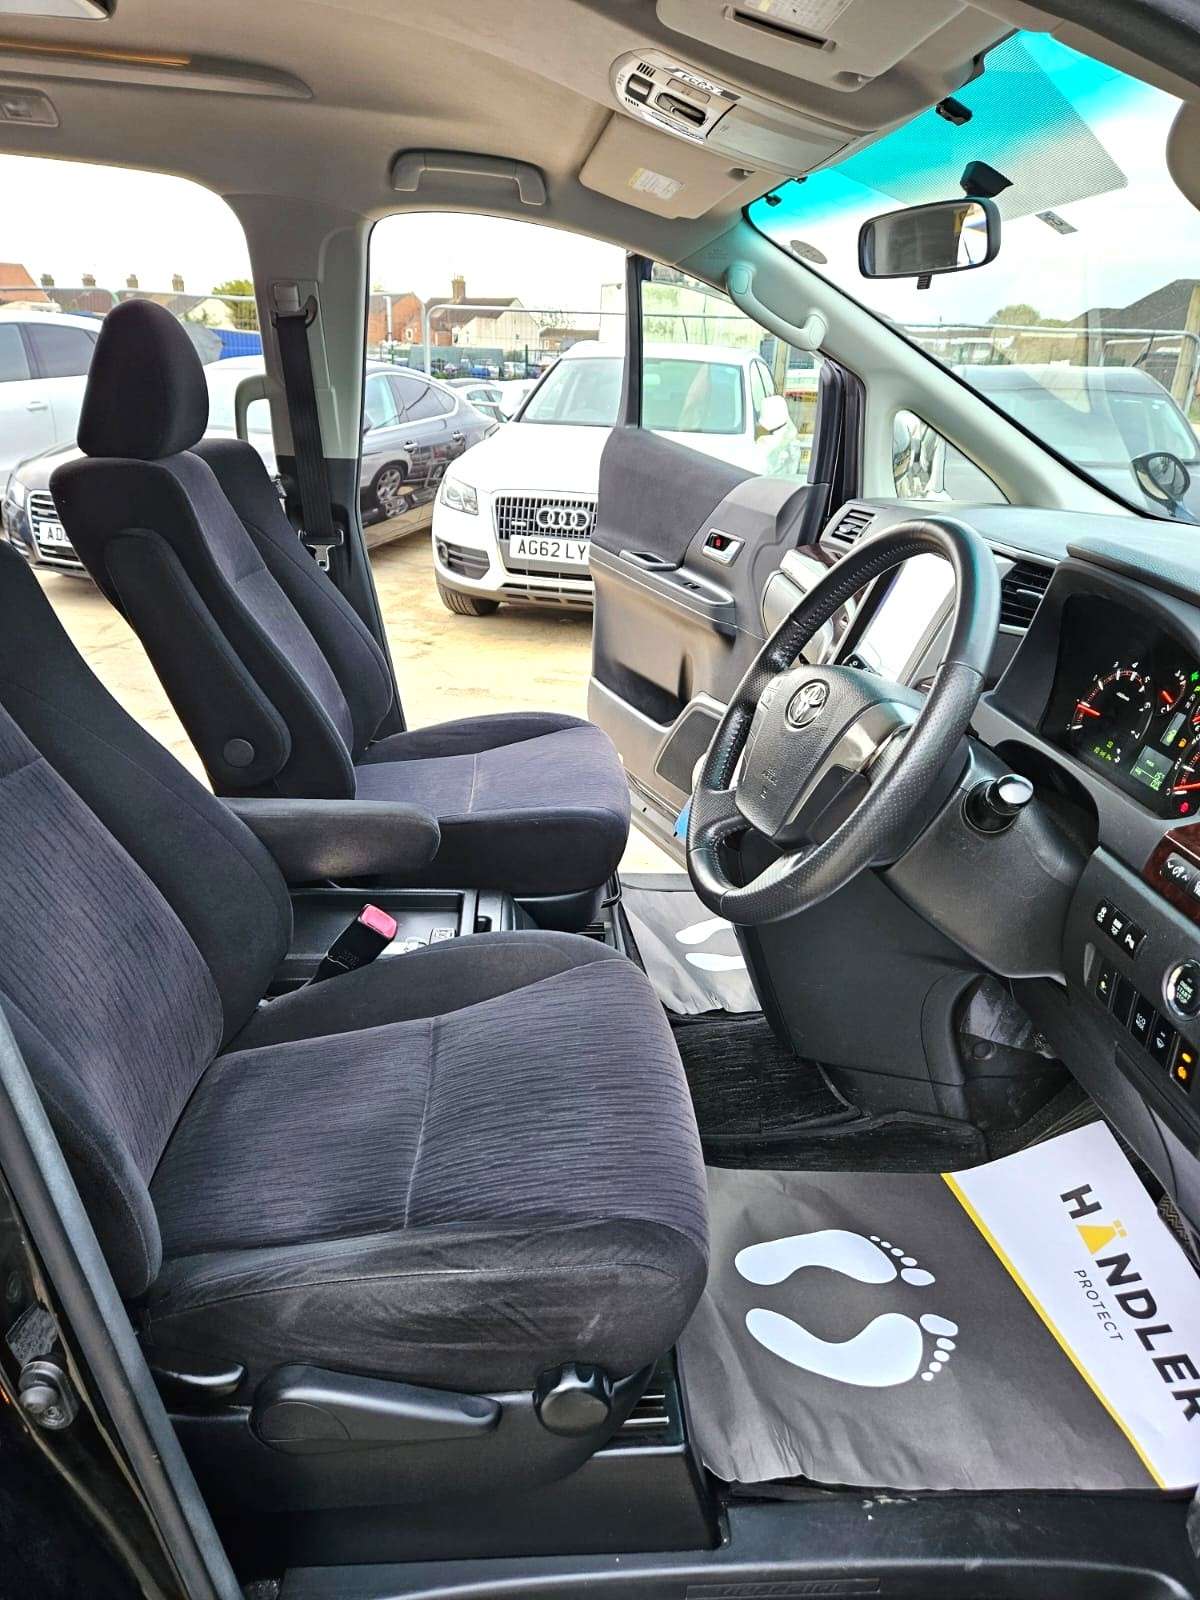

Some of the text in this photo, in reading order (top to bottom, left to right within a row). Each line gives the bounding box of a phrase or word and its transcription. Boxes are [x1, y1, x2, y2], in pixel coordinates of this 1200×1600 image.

[517, 538, 587, 561] AG62 LY
[1073, 1268, 1125, 1343] PROTECT
